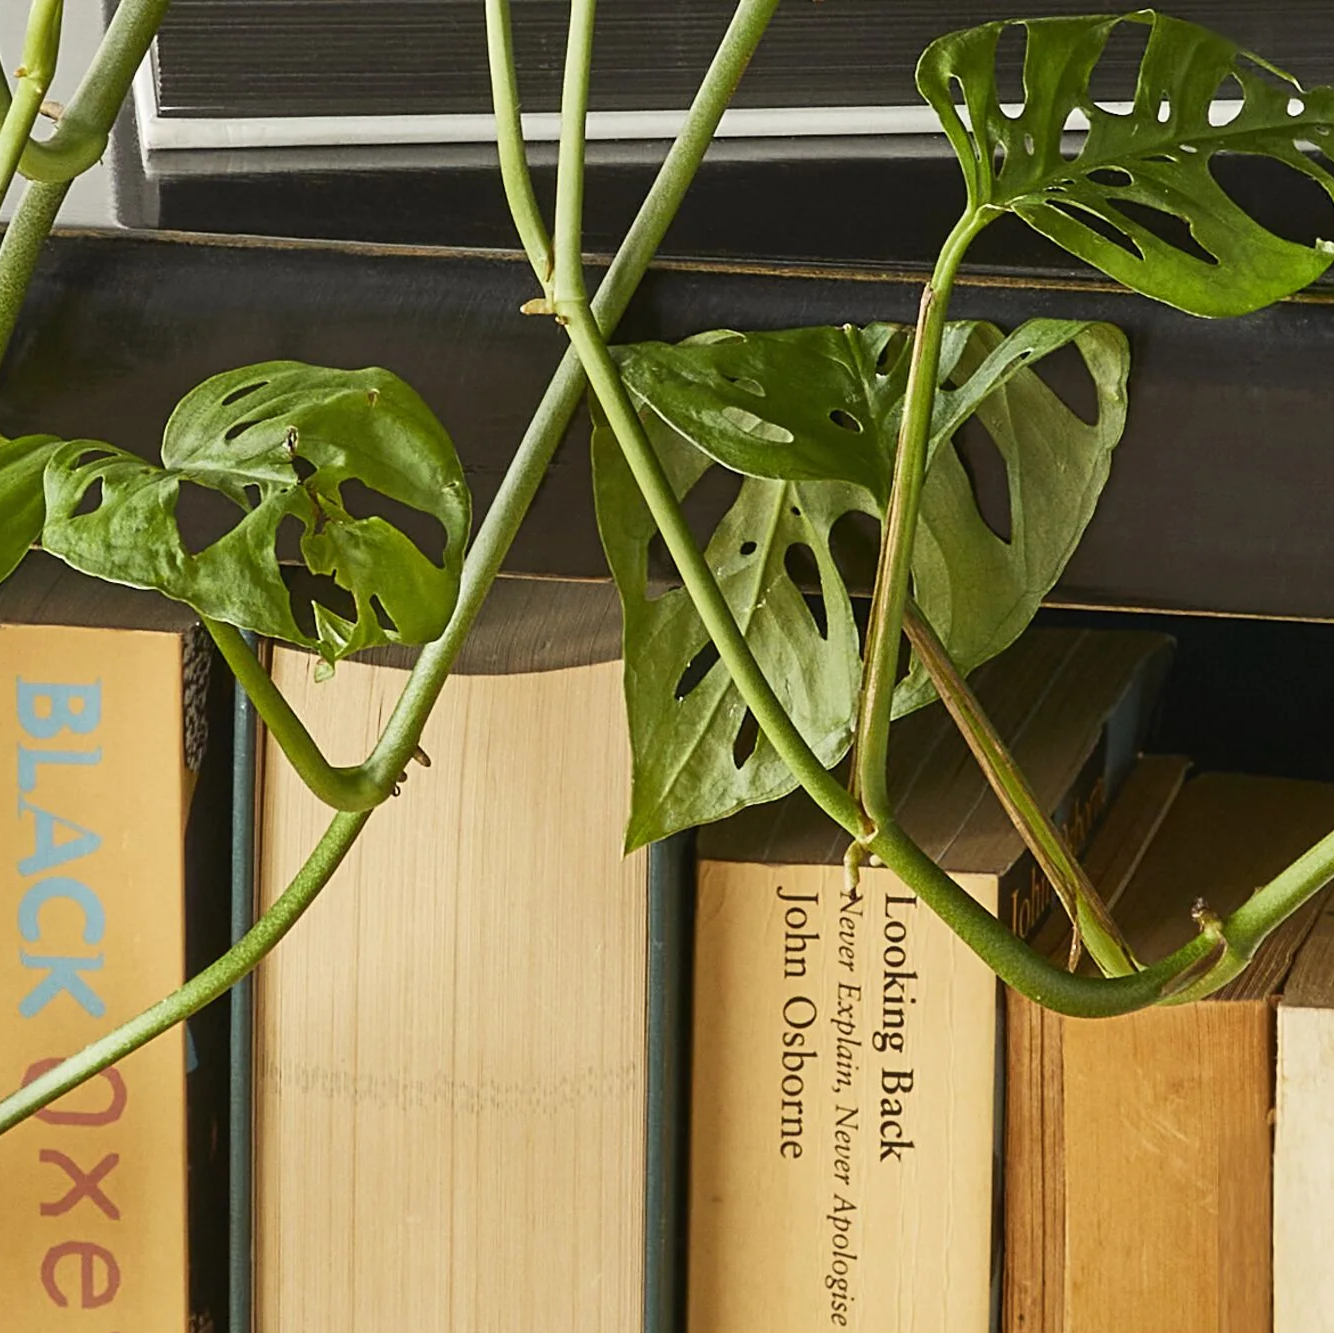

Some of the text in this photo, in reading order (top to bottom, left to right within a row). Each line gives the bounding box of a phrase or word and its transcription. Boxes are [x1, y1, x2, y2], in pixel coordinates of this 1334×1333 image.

[14, 675, 107, 1019] BLACK
[775, 885, 821, 1160] John Osborne
[824, 890, 864, 1328] Never Explain, Never Apologise
[871, 892, 919, 1163] Looking Back
